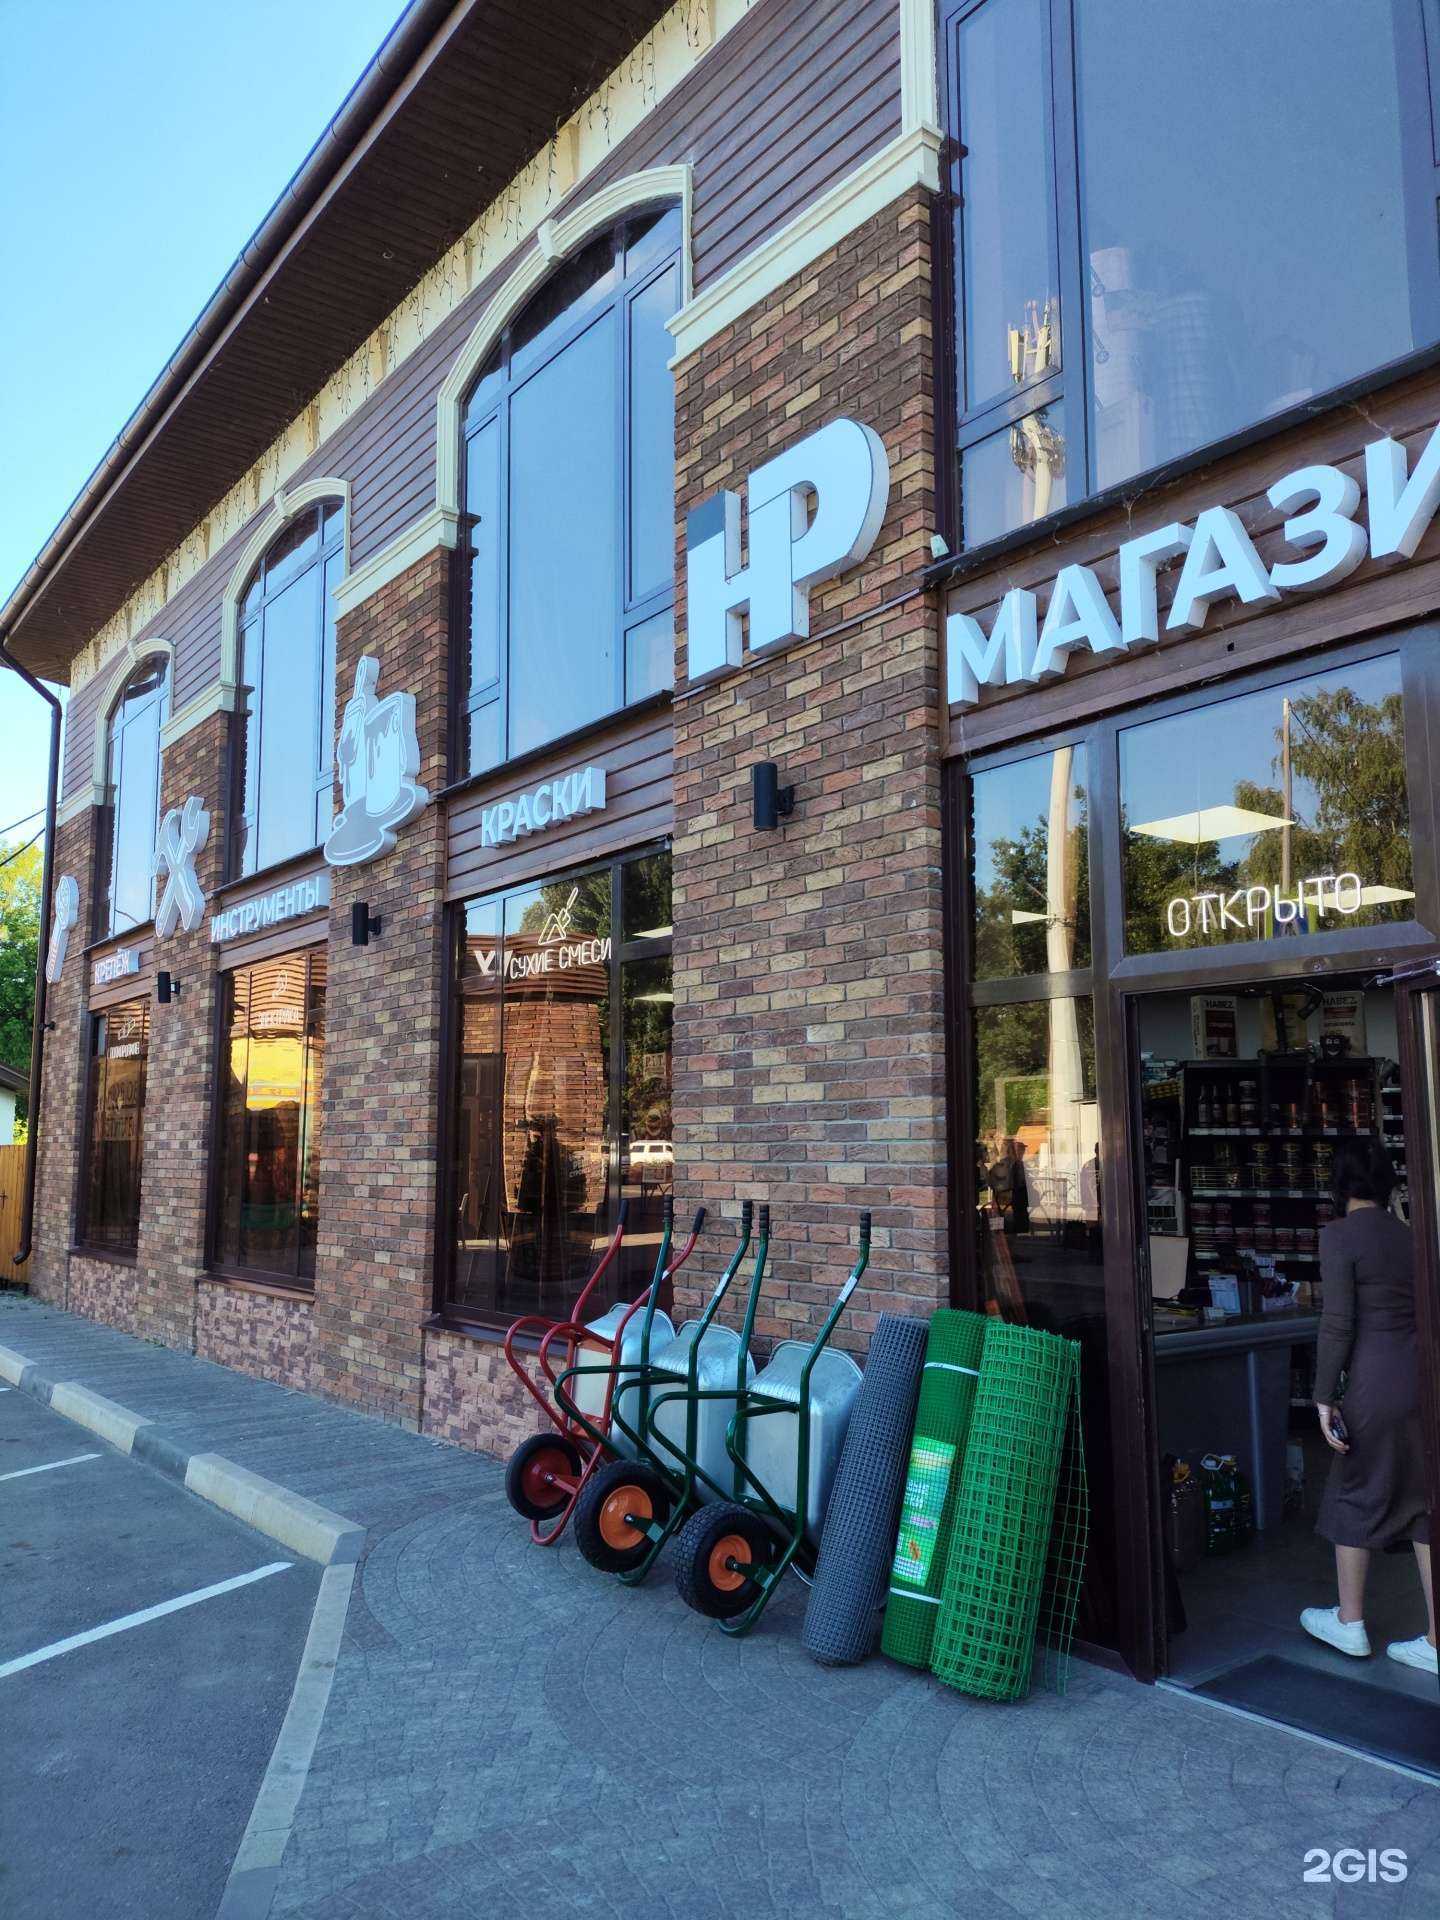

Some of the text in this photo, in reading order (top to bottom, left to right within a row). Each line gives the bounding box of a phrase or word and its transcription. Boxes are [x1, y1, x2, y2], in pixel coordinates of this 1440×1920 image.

[481, 767, 606, 848] КРАСКИ
[211, 876, 326, 943] ИНСТРУМЕНТЫ
[1168, 873, 1361, 936] ОТКРЫТО
[510, 948, 556, 979] СУХИЕ
[559, 937, 612, 969] СМЕСИ
